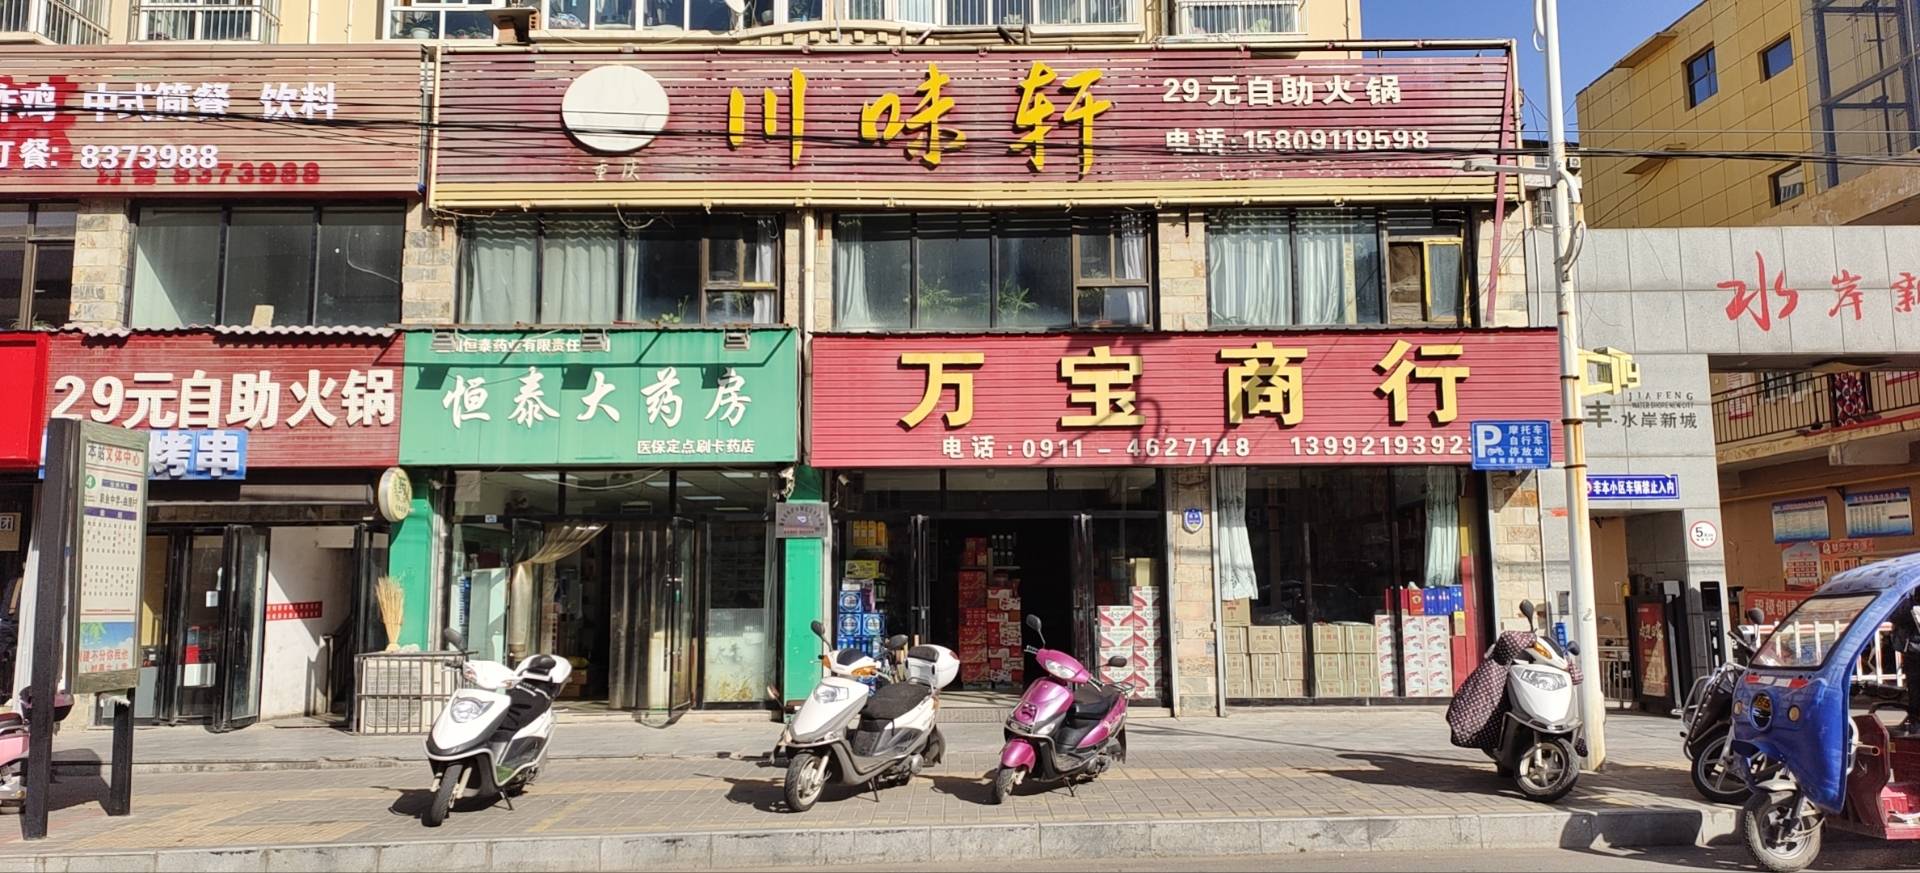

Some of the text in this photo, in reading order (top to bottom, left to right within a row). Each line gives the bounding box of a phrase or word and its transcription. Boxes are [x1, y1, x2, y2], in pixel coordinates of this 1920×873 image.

[83, 83, 230, 121] 中式简餐
[260, 83, 338, 119] 饮料
[1162, 75, 1401, 106] 29元自助火锅
[728, 60, 1113, 175] 川味轩
[80, 144, 219, 169] 8373988
[897, 338, 1470, 428] 万宝商行
[51, 369, 395, 429] 29元自助火锅
[442, 366, 752, 428] 恒泰大药房
[1628, 391, 1694, 402] JIAFENG
[1476, 424, 1503, 459] P
[1508, 425, 1544, 435] 摩托车
[1509, 436, 1544, 446] 自行车
[637, 439, 755, 455] 医保定点刷卡药店
[1509, 447, 1545, 457] 停放处
[1695, 526, 1704, 538] 5
[1754, 598, 1802, 617] 积极创建
